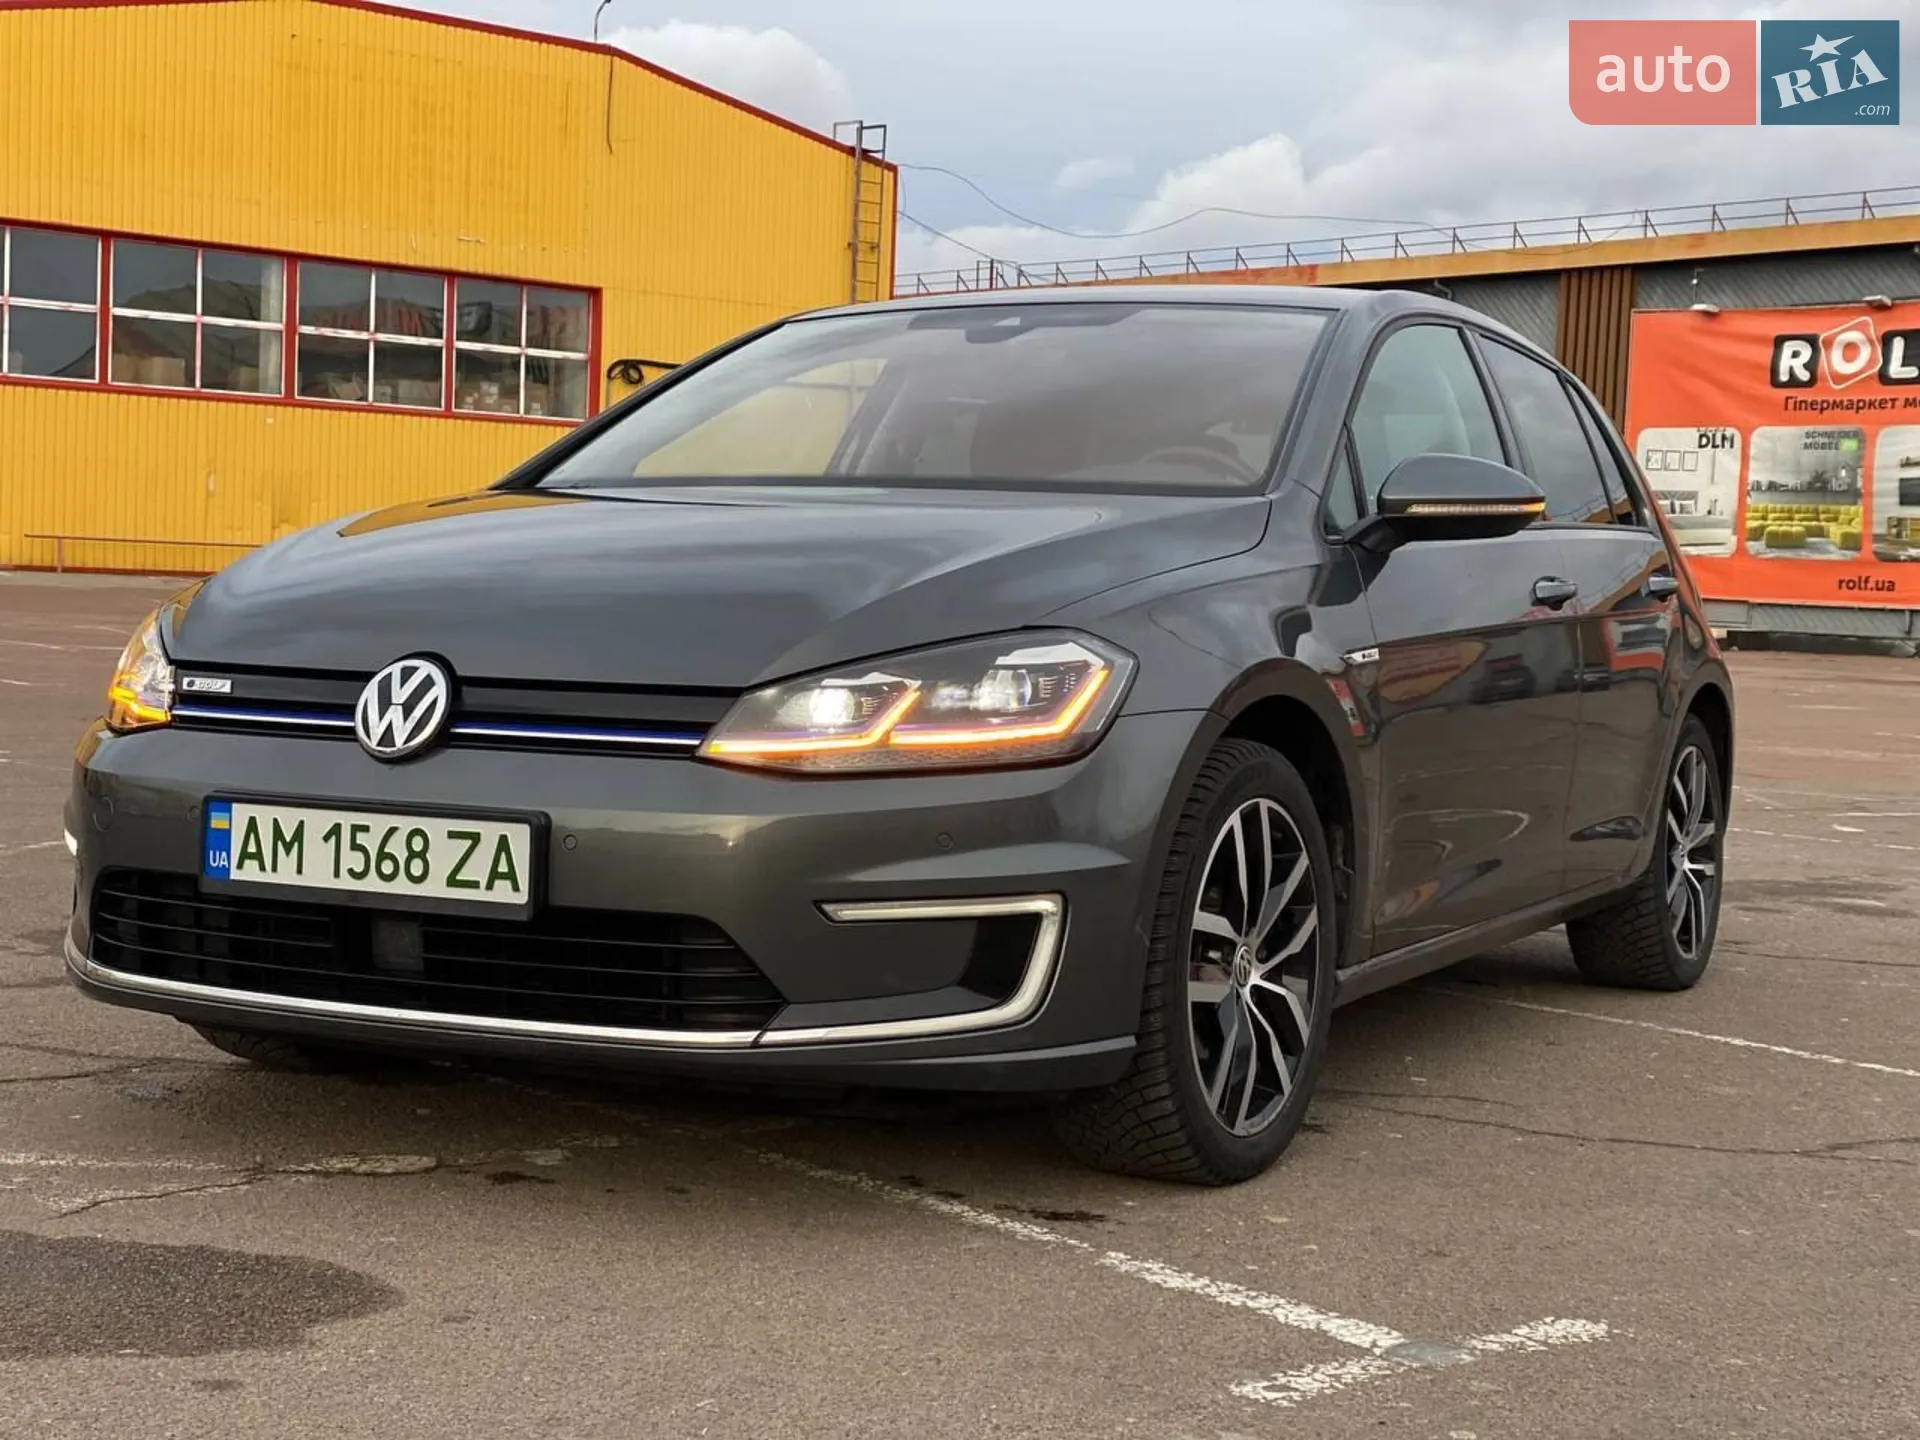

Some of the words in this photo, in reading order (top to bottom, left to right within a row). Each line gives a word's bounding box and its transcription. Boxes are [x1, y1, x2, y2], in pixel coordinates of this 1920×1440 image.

[1779, 330, 1920, 382] ROL
[1783, 396, 1899, 414] Гіпермаркет
[1902, 397, 1920, 410] м
[1838, 576, 1896, 592] rolf.ua
[209, 849, 230, 869] UA
[236, 815, 306, 876] AM
[321, 821, 431, 885] 1568
[445, 829, 521, 893] ZA
